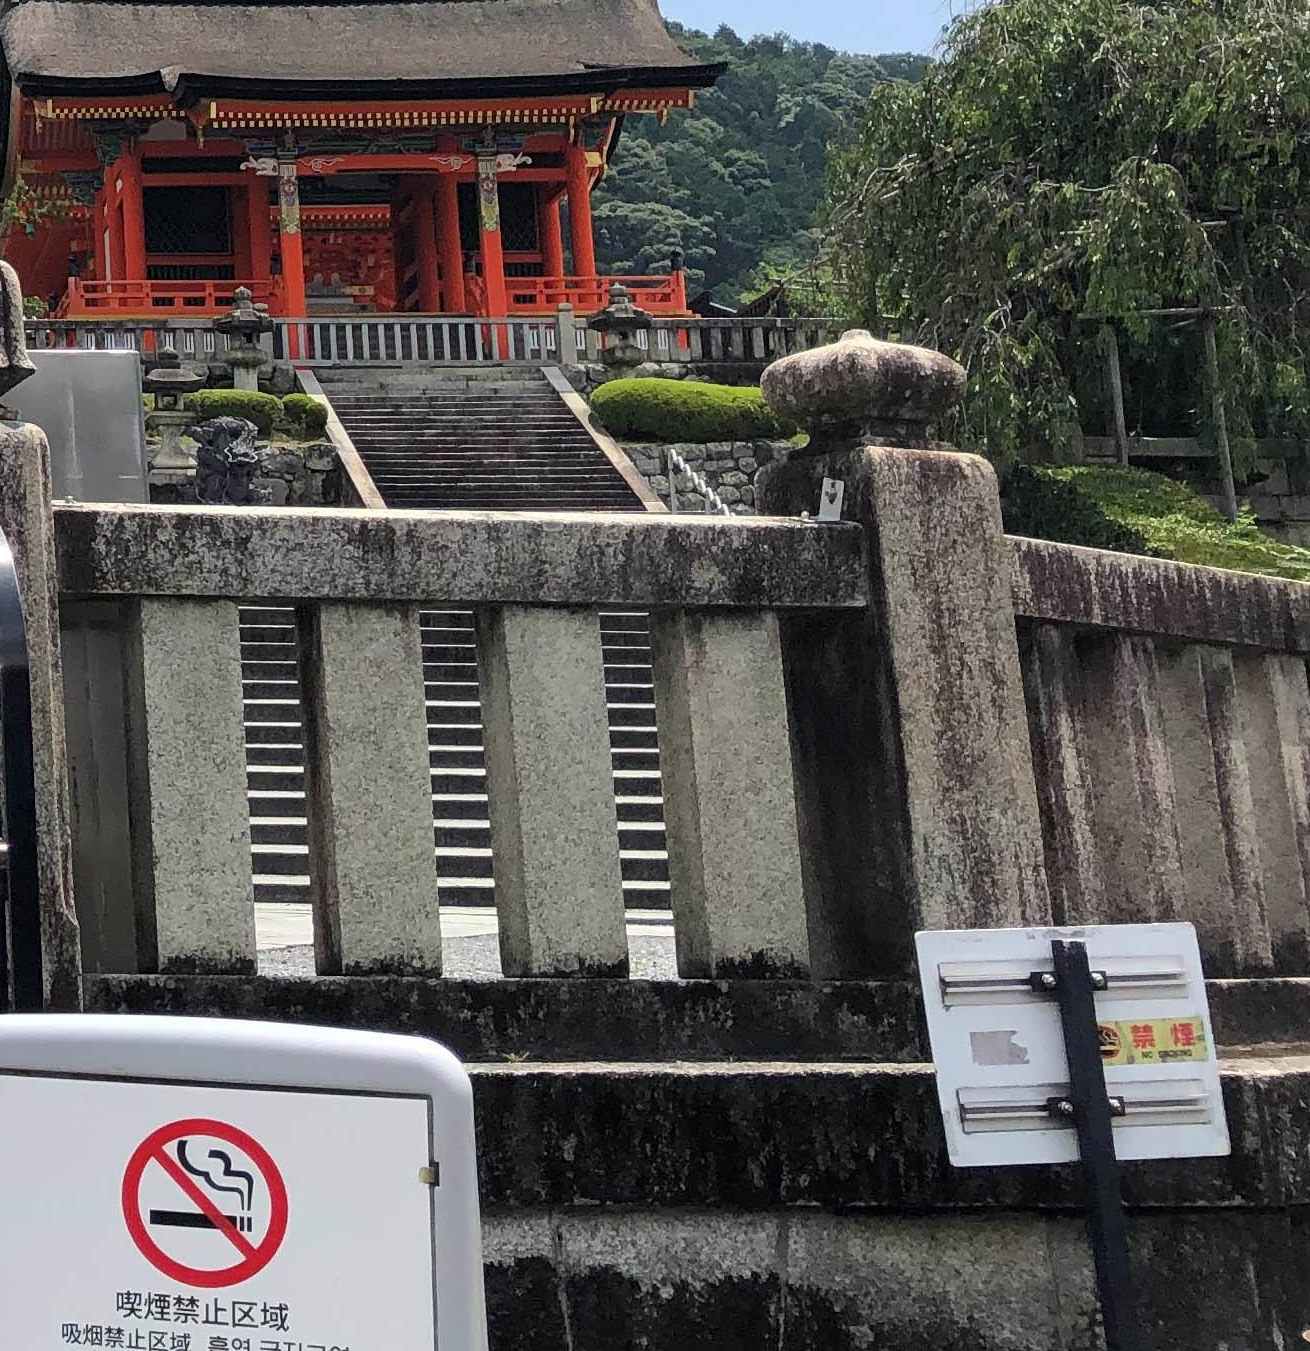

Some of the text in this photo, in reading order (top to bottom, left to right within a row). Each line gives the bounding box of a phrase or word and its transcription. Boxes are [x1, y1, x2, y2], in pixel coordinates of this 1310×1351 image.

[115, 1290, 290, 1332] 喫煙禁止区域
